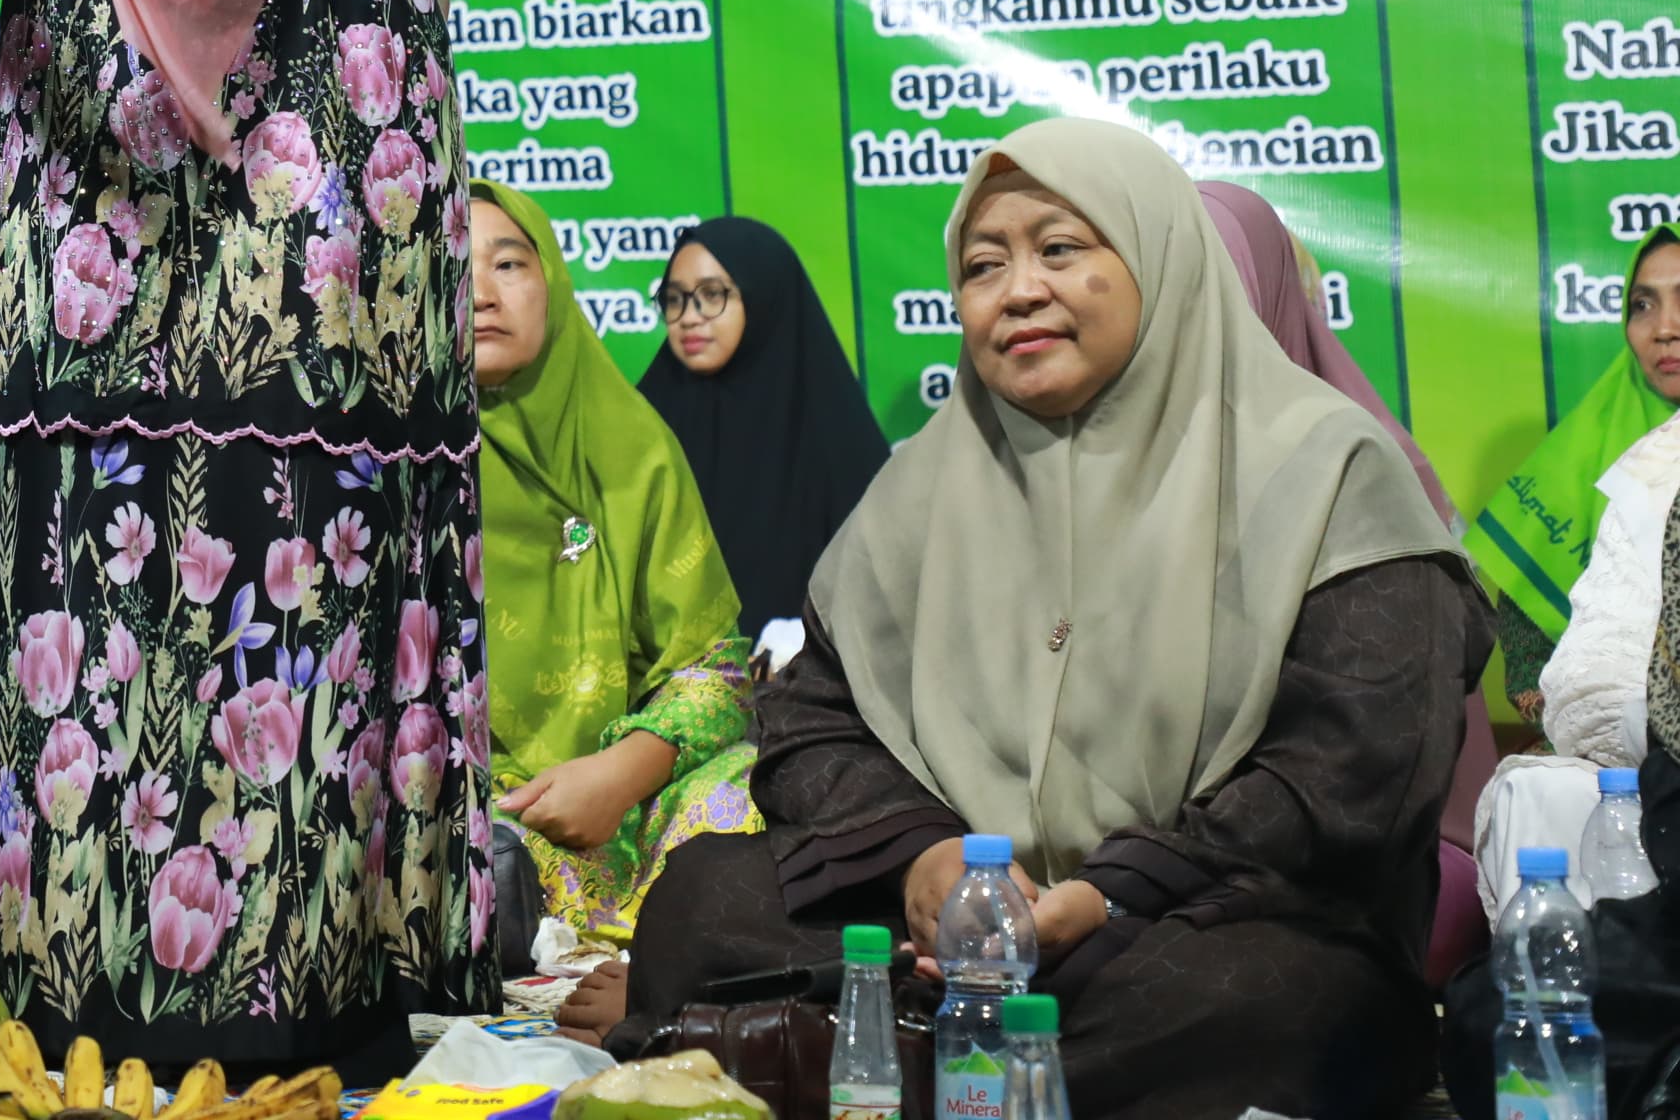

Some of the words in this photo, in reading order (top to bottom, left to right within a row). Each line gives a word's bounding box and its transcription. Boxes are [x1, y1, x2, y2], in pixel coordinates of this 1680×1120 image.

[531, 0, 703, 41] biarkan
[1105, 47, 1322, 103] perilaku
[526, 80, 631, 122] yang
[1549, 108, 1673, 155] Jika
[857, 135, 996, 177] hidu
[967, 1084, 988, 1102] Le
